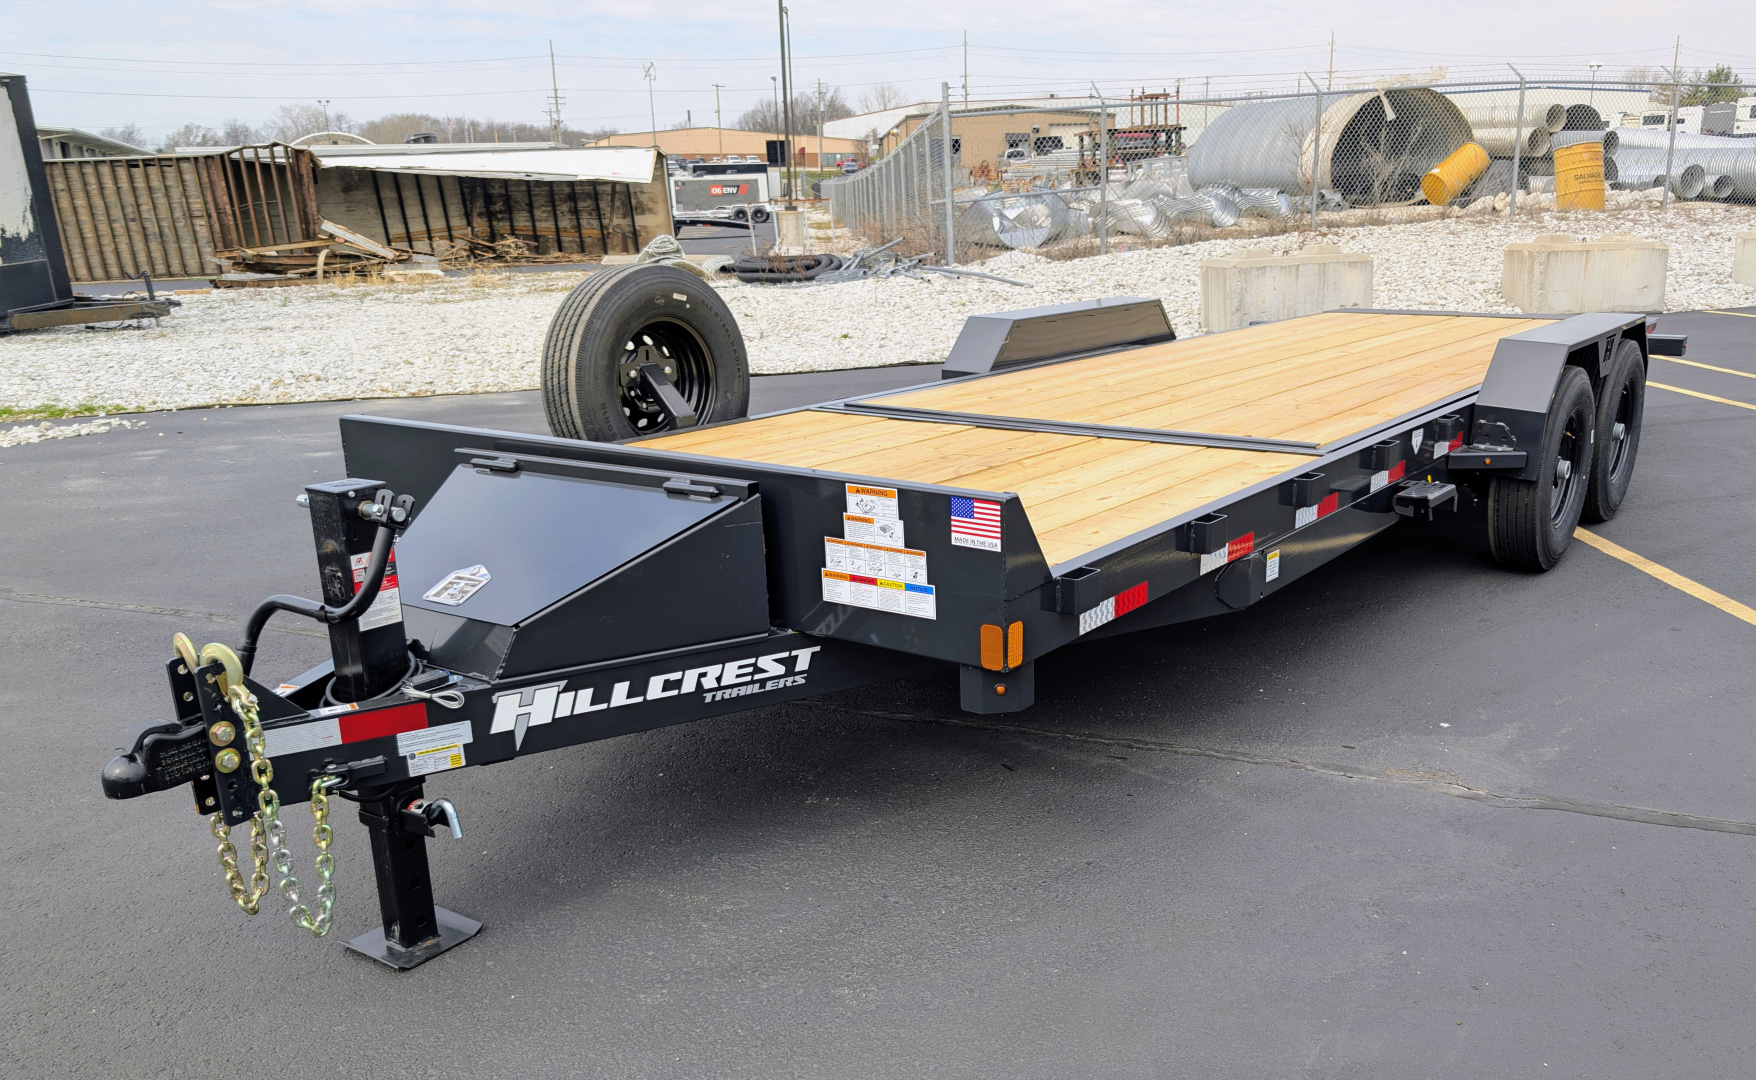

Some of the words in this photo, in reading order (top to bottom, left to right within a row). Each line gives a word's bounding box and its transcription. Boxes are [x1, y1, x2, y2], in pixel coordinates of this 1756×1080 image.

[730, 340, 743, 380] RADIAL
[861, 488, 888, 497] WARNING
[954, 536, 969, 545] MADE
[883, 581, 903, 589] CAUTION
[702, 673, 808, 703] TRAILERS
